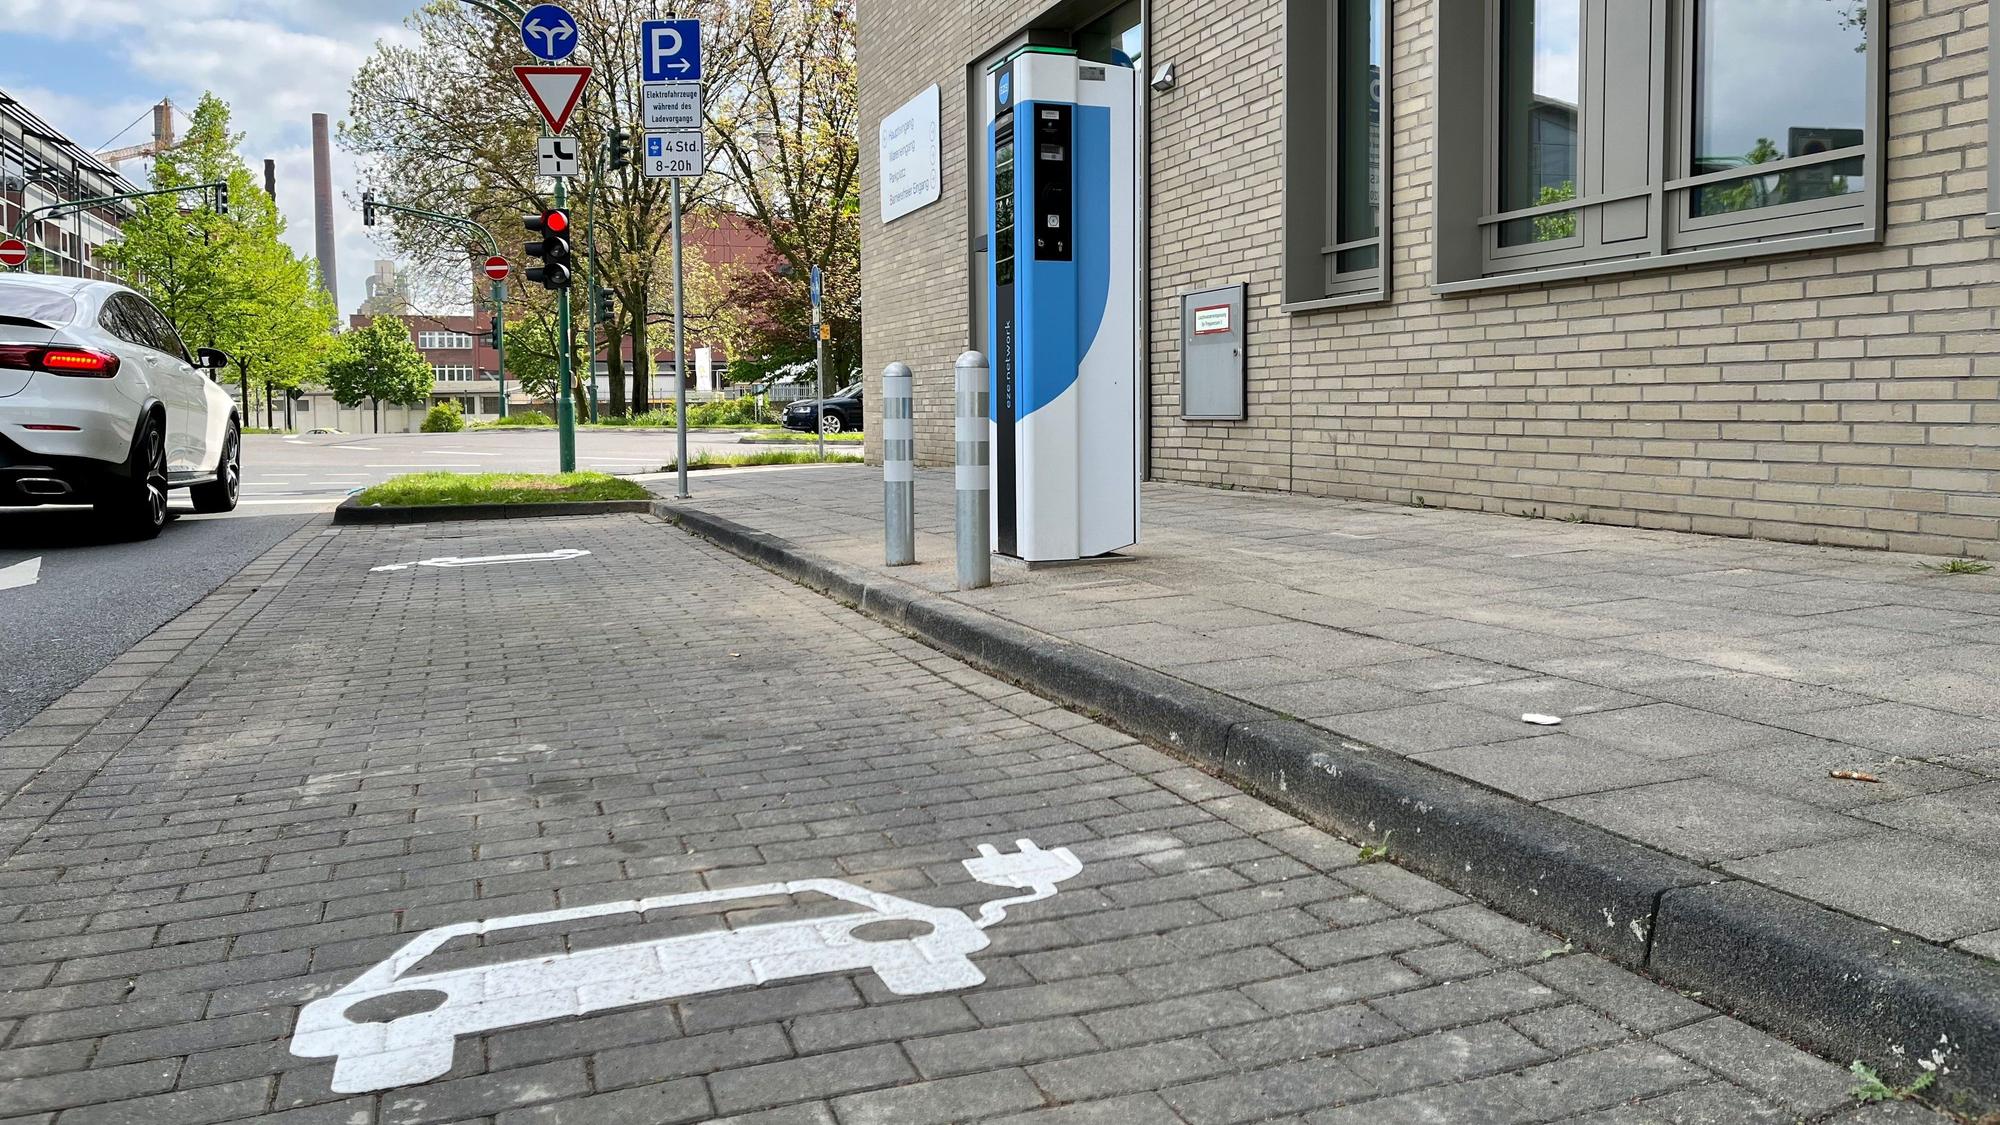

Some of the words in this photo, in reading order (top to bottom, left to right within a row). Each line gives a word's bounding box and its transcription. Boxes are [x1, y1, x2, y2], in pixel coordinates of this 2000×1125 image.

[652, 28, 683, 74] P
[646, 90, 698, 99] Elektrofahrzeuge
[653, 101, 679, 111] während
[680, 101, 692, 110] des
[651, 113, 693, 124] Ladevorgangs
[665, 141, 673, 152] 4
[676, 140, 700, 152] Std.
[656, 160, 692, 171] 8-20h
